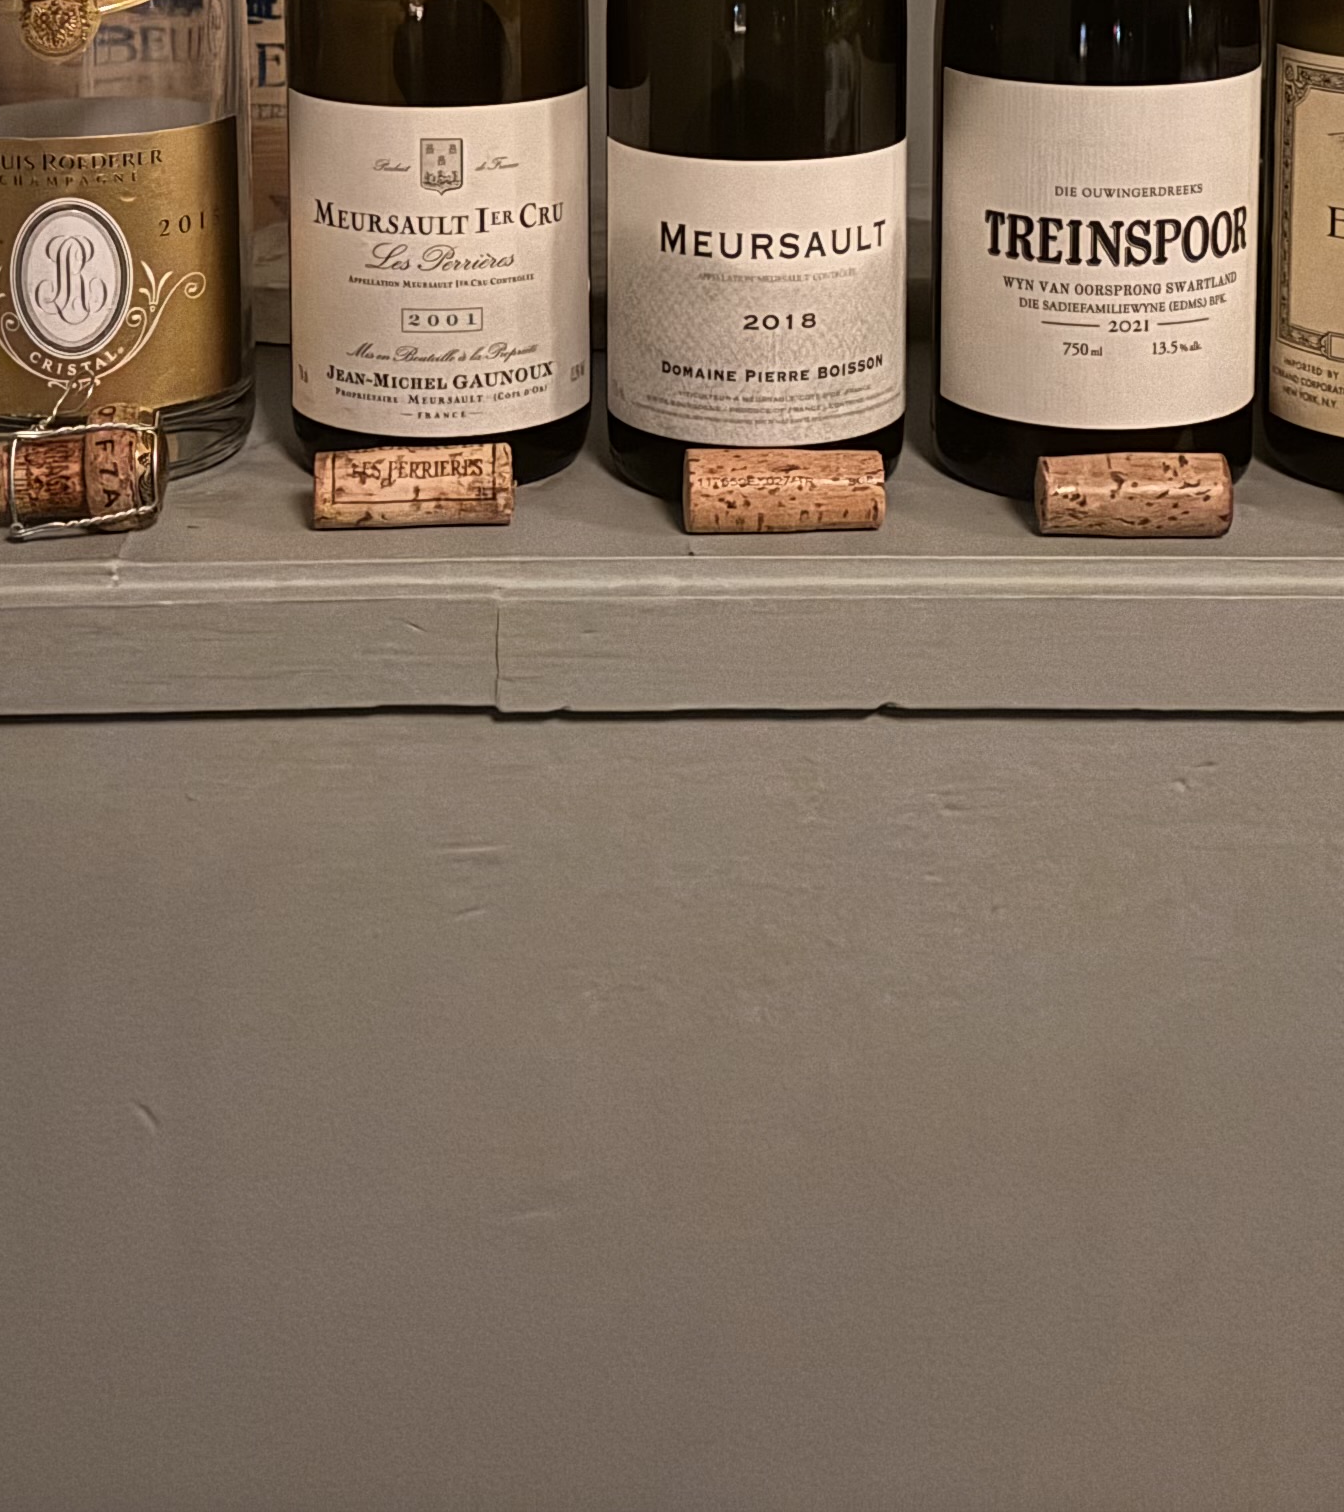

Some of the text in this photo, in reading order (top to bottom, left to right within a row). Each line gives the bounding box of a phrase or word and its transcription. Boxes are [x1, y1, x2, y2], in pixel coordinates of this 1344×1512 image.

[43, 149, 163, 171] ROEDERER
[0, 170, 137, 186] CHAMPAGNE
[1055, 184, 1203, 198] DIE OUWINGERDREEKS
[313, 198, 469, 236] MEURSAULT
[519, 202, 564, 229] CRU
[661, 219, 886, 259] MEURSAULT
[985, 206, 1247, 267] TREINSPOOR
[365, 242, 515, 272] Les Perrières
[348, 274, 400, 289] APPELLATION
[403, 279, 453, 289] MEURSAULT
[1003, 272, 1237, 296] WYN VAN OORSPRONG SWARTLAND
[1019, 297, 1167, 314] DIE SADIEFAMILIEWYNE
[407, 312, 477, 328] 2001
[743, 313, 817, 330] 2018
[1108, 320, 1150, 333] 2021
[392, 345, 456, 363] Bouteille
[326, 364, 448, 390] JEAN-MICHEL
[452, 360, 554, 390] GAUNOUX
[662, 354, 883, 383] DOMAINE PIERRE BOISSON
[1327, 370, 1340, 380] BY
[407, 395, 484, 405] MEURSAULT
[417, 411, 467, 420] FRANCE
[353, 460, 381, 480] LES
